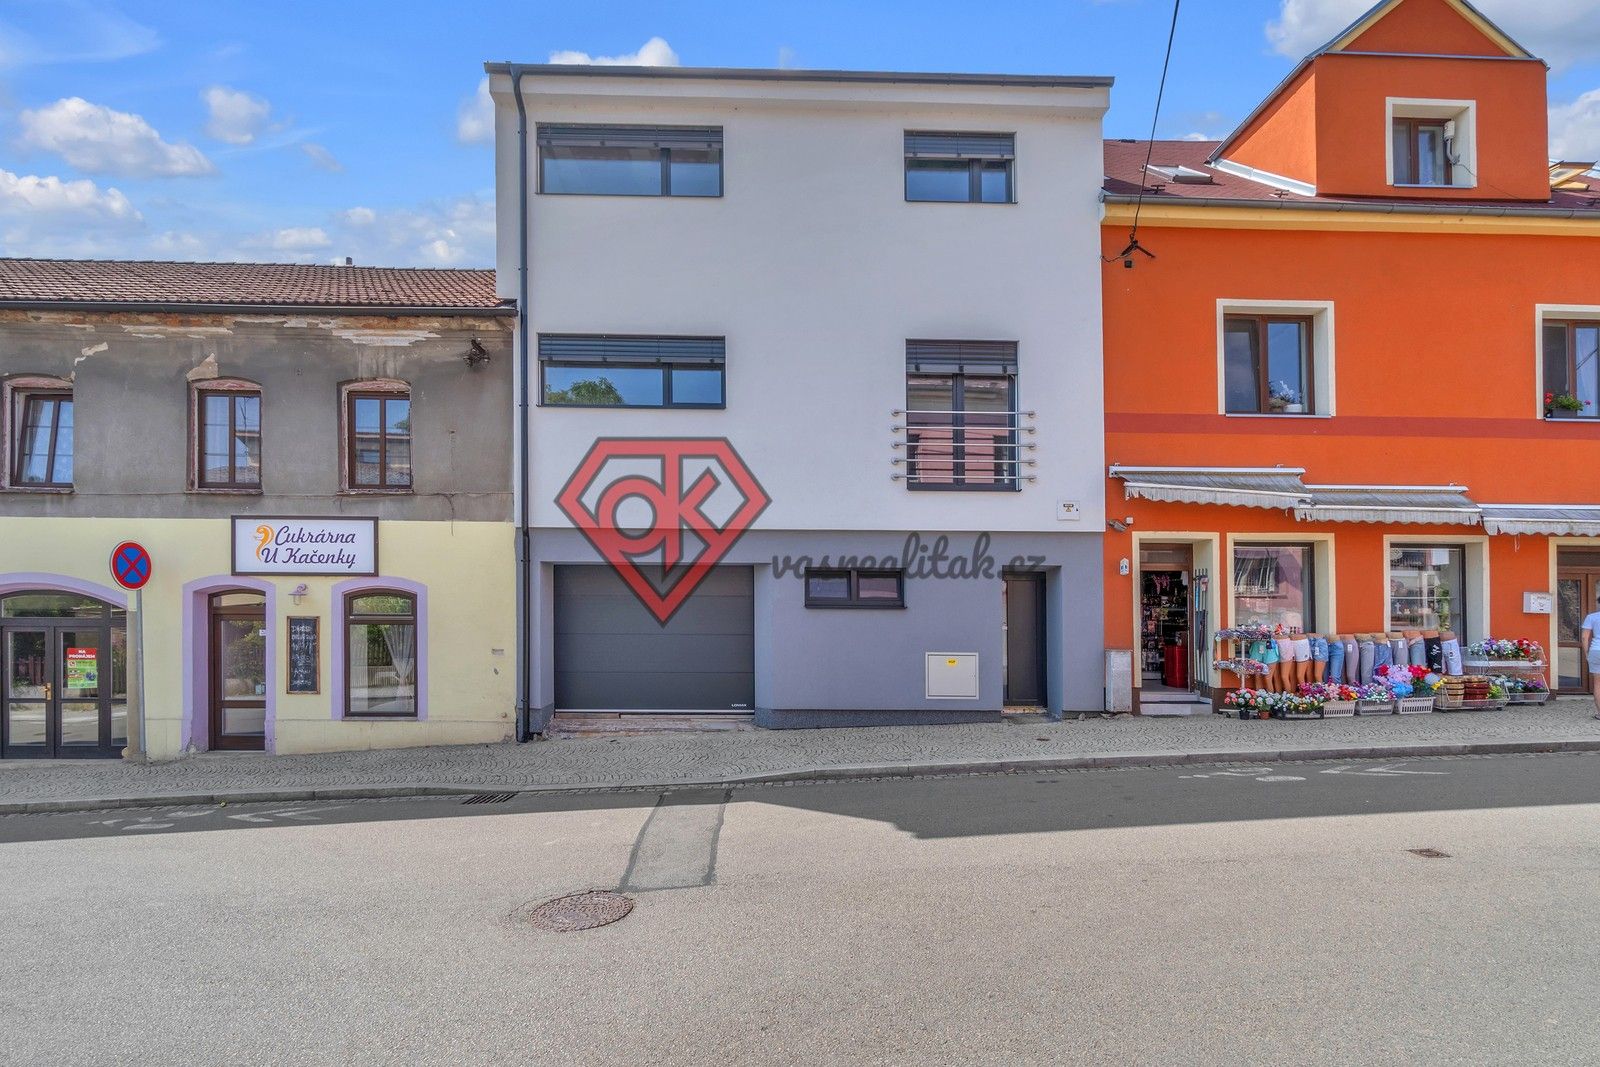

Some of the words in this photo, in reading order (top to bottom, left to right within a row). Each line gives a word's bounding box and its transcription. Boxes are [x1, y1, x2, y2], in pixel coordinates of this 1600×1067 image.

[275, 526, 356, 545] Cukrárna
[261, 547, 279, 564] U
[282, 548, 356, 569] Kačenky
